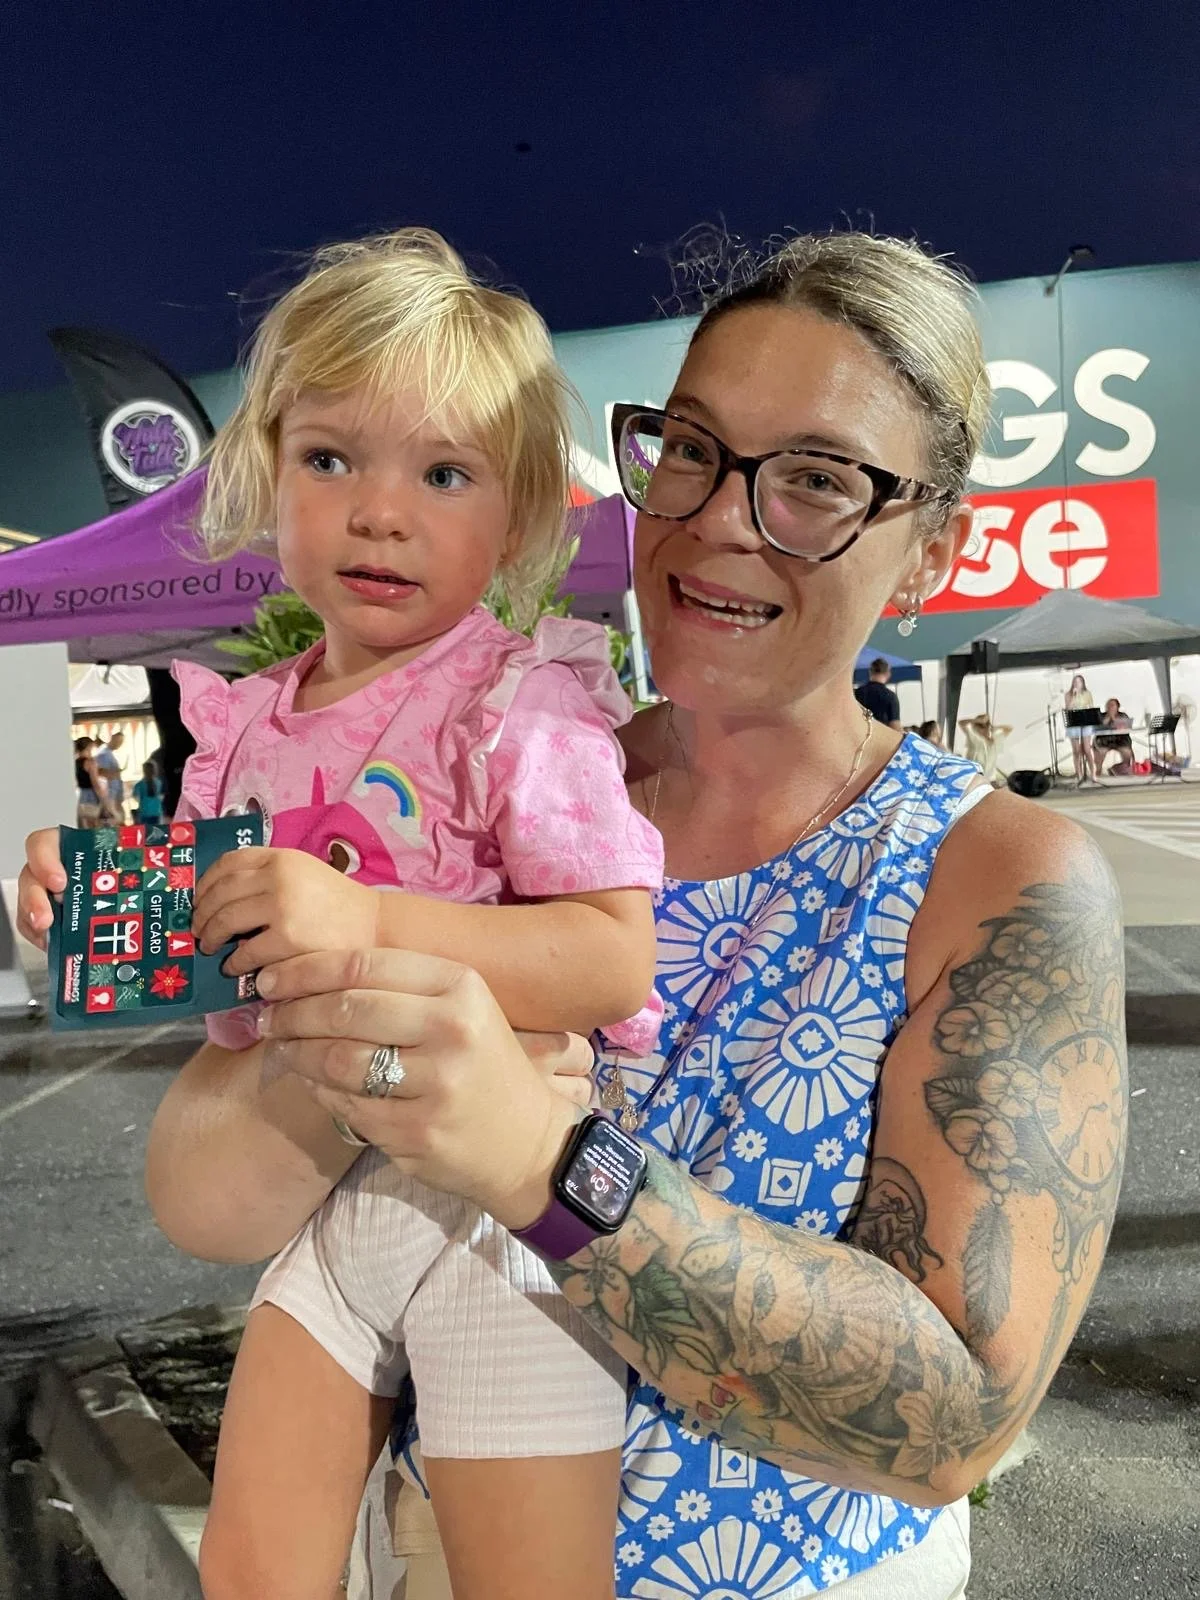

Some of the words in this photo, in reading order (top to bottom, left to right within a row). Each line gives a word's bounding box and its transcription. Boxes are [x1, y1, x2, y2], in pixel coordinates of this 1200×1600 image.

[0, 588, 41, 617] dly
[54, 569, 222, 615] sponsored
[234, 567, 276, 596] by
[71, 851, 85, 881] Merry
[71, 884, 84, 932] Christmas
[150, 894, 163, 919] GIFT
[149, 922, 162, 954] CARD
